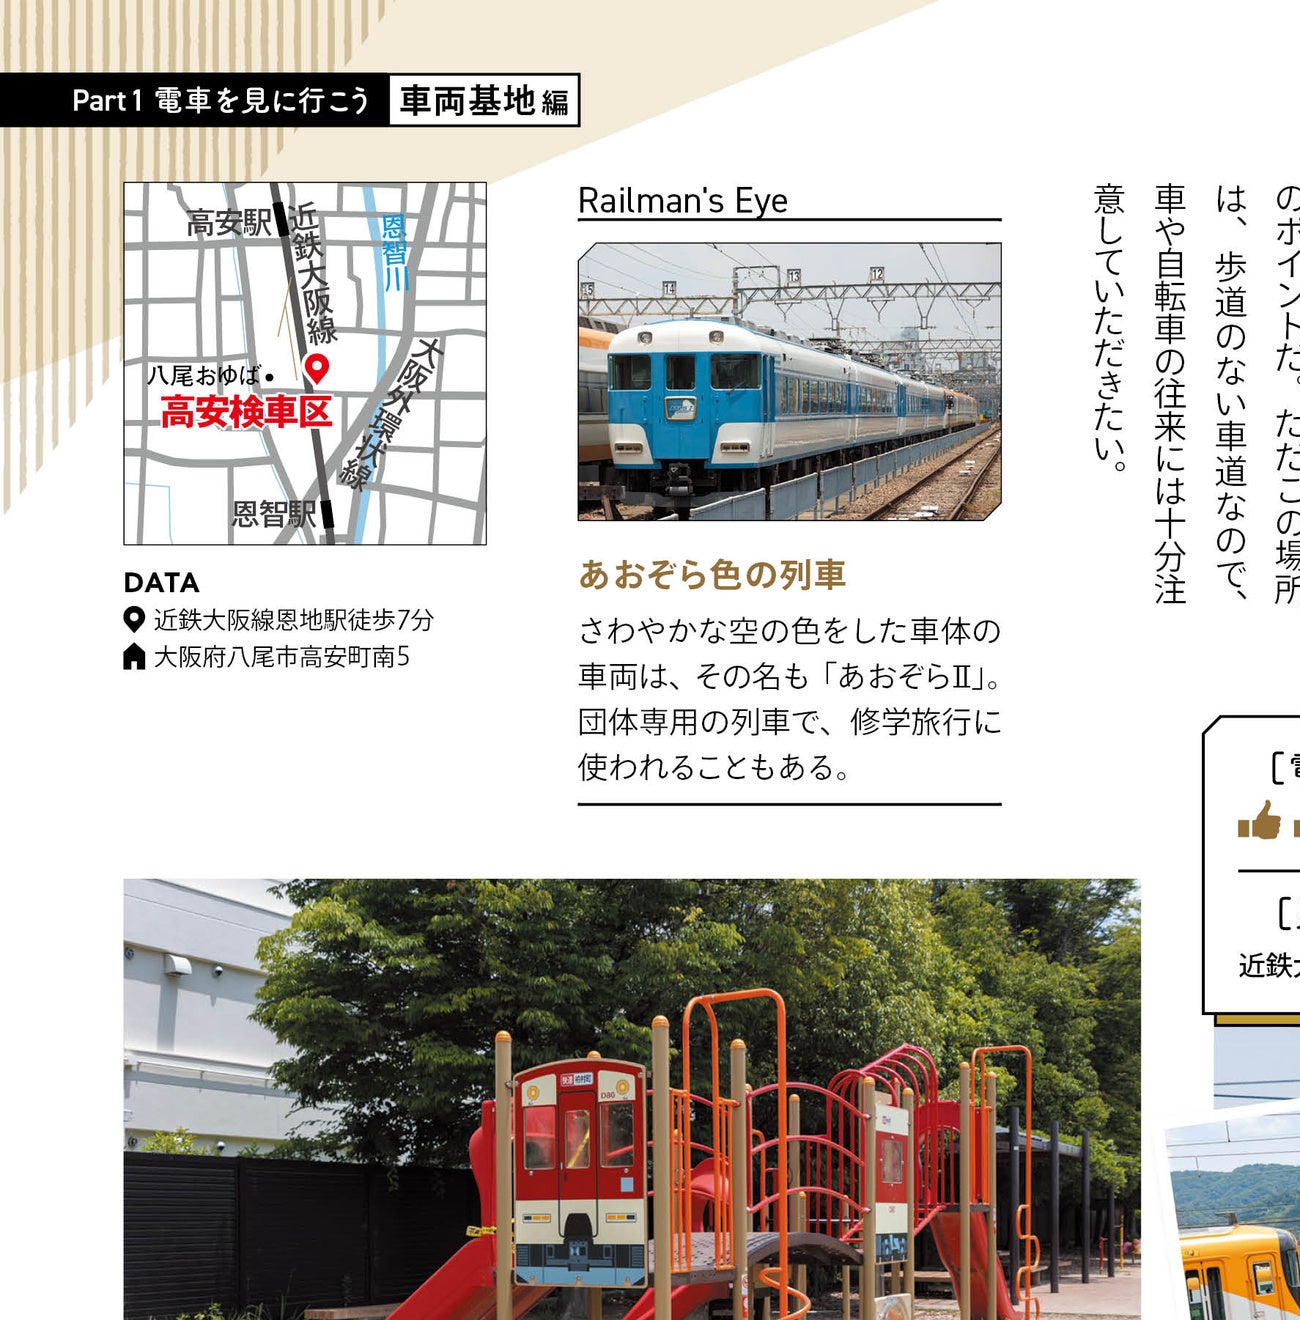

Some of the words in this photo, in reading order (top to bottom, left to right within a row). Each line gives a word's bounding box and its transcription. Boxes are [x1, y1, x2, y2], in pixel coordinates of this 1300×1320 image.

[156, 86, 366, 114] 電車を見に行こう
[580, 187, 723, 213] Railman's
[737, 187, 787, 218] Eye
[186, 207, 271, 237] 高安駅
[381, 212, 410, 291] 恩智川
[287, 201, 338, 345] 近鉄大阪線
[790, 270, 800, 281] 13
[872, 268, 882, 279] 12
[664, 283, 674, 294] 14
[1094, 183, 1125, 471] 意していただきたい。
[147, 364, 262, 386] 八尾おゆば
[1154, 183, 1186, 603] 車や自転車の往来には十分注
[1216, 185, 1247, 599] は、歩道のない車道なので、
[161, 394, 332, 428] 高安検車区
[338, 337, 443, 492] 大阪外環状線
[231, 500, 317, 529] 恩智駅
[125, 572, 200, 592] DATA
[580, 558, 846, 590] あおぞら色の列車
[155, 608, 434, 631] 近鉄大阪線恩地駅徒歩7分
[582, 617, 1000, 645] さわやかな空の色をした車体の
[155, 645, 409, 668] 大阪府八尾市高安町南5
[579, 662, 996, 690] 車両は、その名も「あおぞらⅡ」。
[580, 707, 1000, 736] 団体専用の列車で、修学旅行に
[578, 753, 845, 781] 使われることもある。
[600, 1091, 616, 1099] D80
